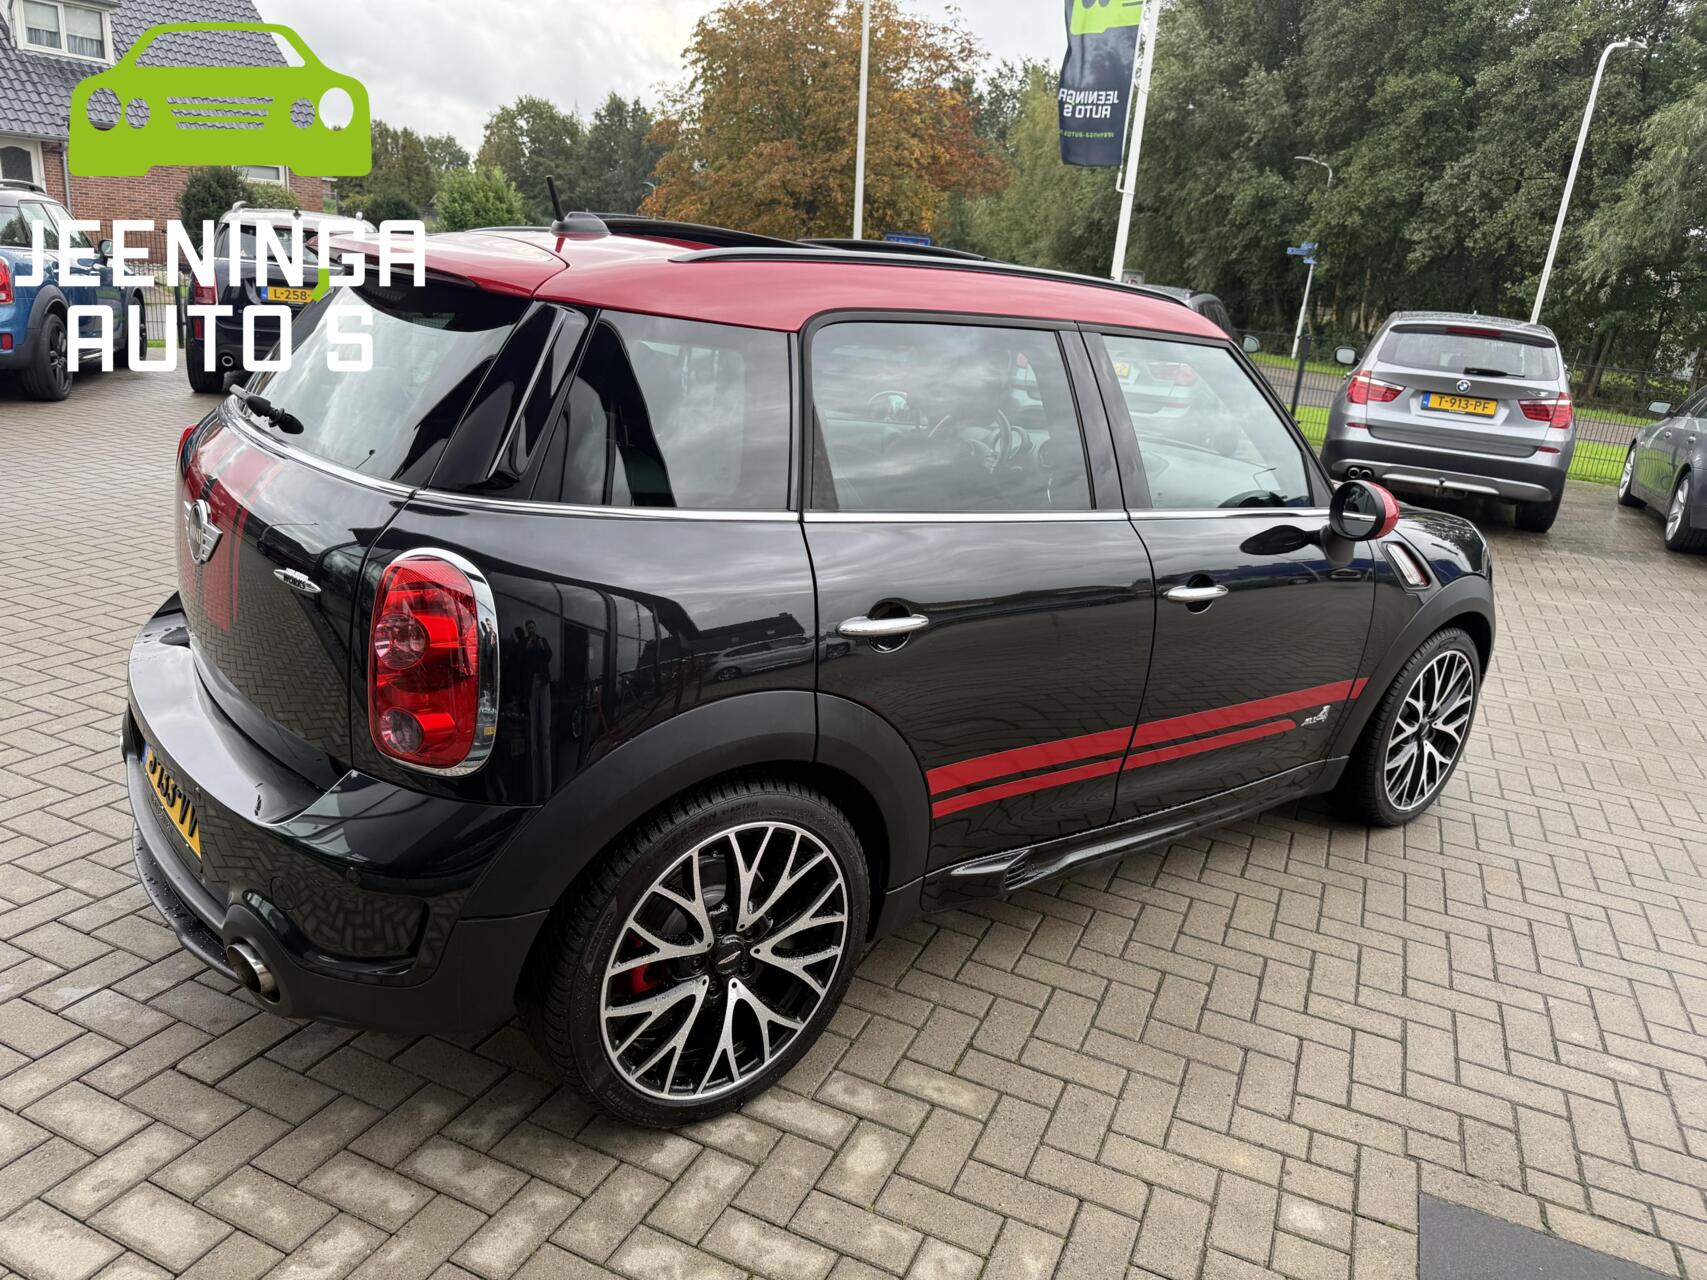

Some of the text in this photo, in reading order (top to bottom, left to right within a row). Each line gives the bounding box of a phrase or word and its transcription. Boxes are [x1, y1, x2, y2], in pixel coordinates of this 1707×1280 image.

[273, 289, 312, 301] L-258-
[1438, 395, 1489, 412] T-913-PF
[283, 573, 306, 590] WORKS
